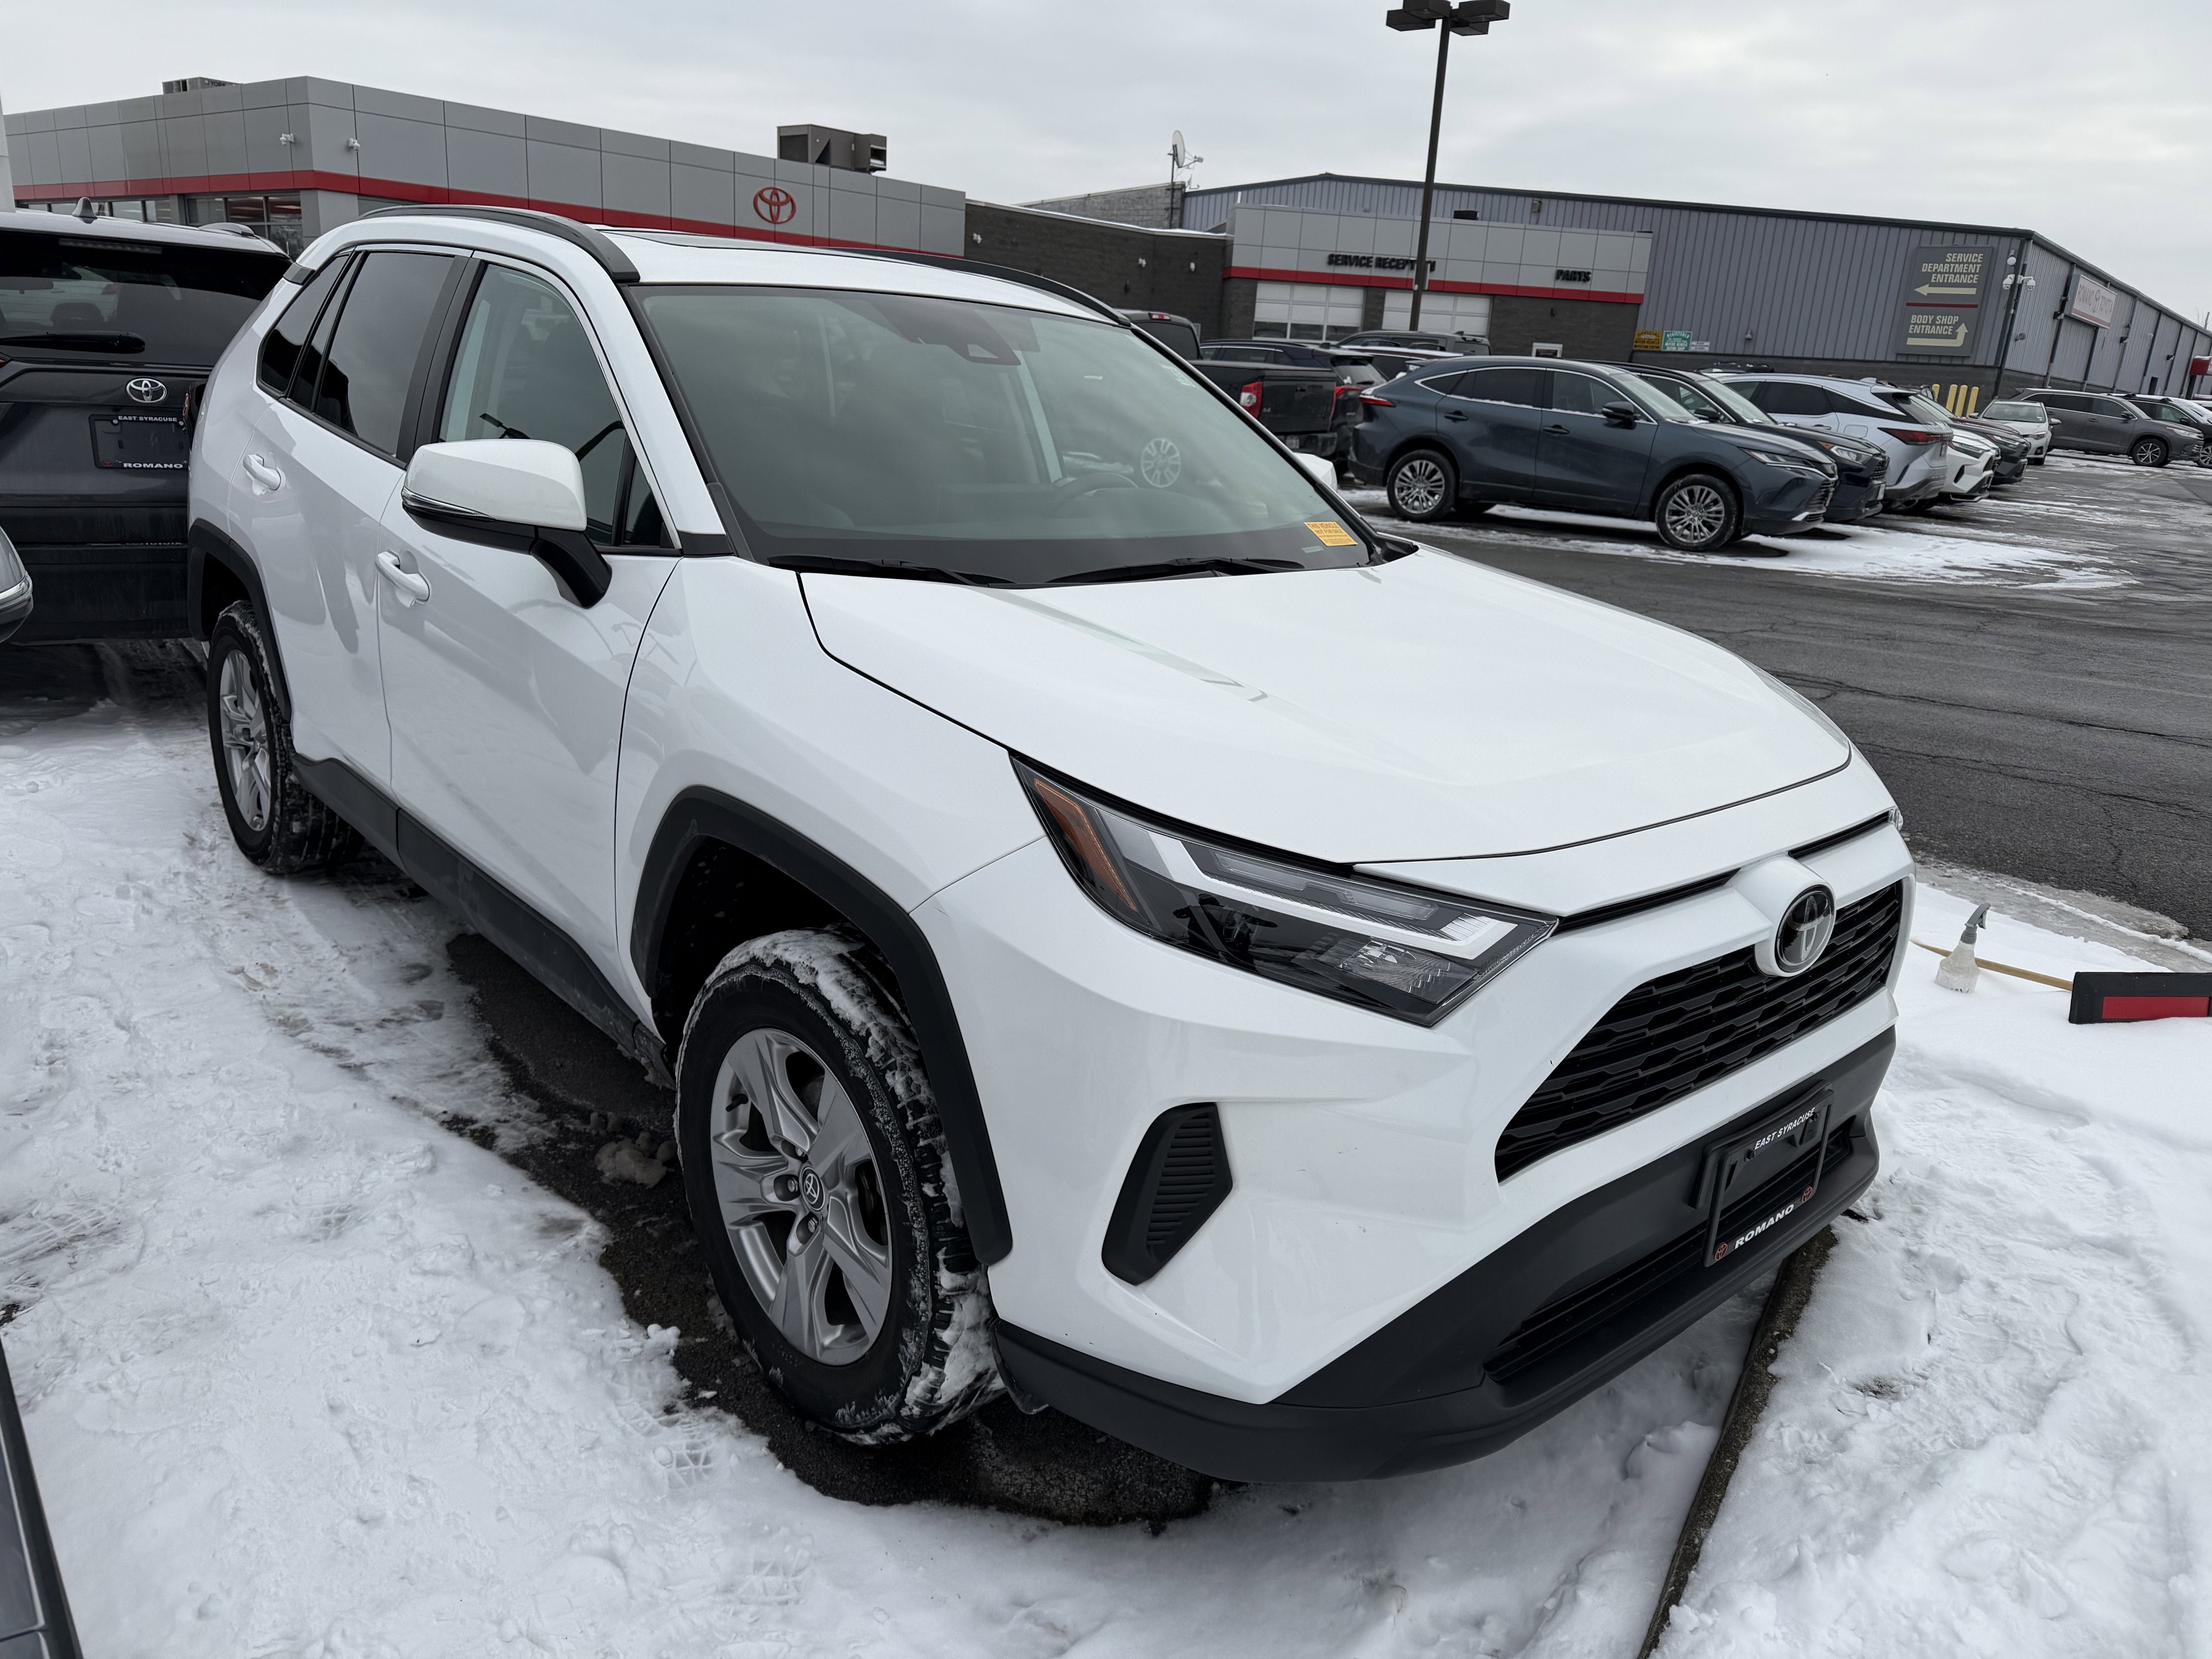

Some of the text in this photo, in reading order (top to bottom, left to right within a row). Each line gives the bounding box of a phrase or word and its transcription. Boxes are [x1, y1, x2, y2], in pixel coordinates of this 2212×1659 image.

[1946, 253, 1983, 262] SERVICE
[1328, 254, 1436, 272] SERVICE RECEPTN
[1922, 263, 1981, 273] DEPARTMENT
[1556, 270, 1591, 282] PARTS
[1931, 274, 1978, 283] ENTRANCE
[1911, 315, 1959, 325] BODY SHOP
[1909, 325, 1953, 334] ENTRANCE
[1754, 1107, 1816, 1150] EAST SYRACUSE
[1735, 1204, 1795, 1250] ROMANO
